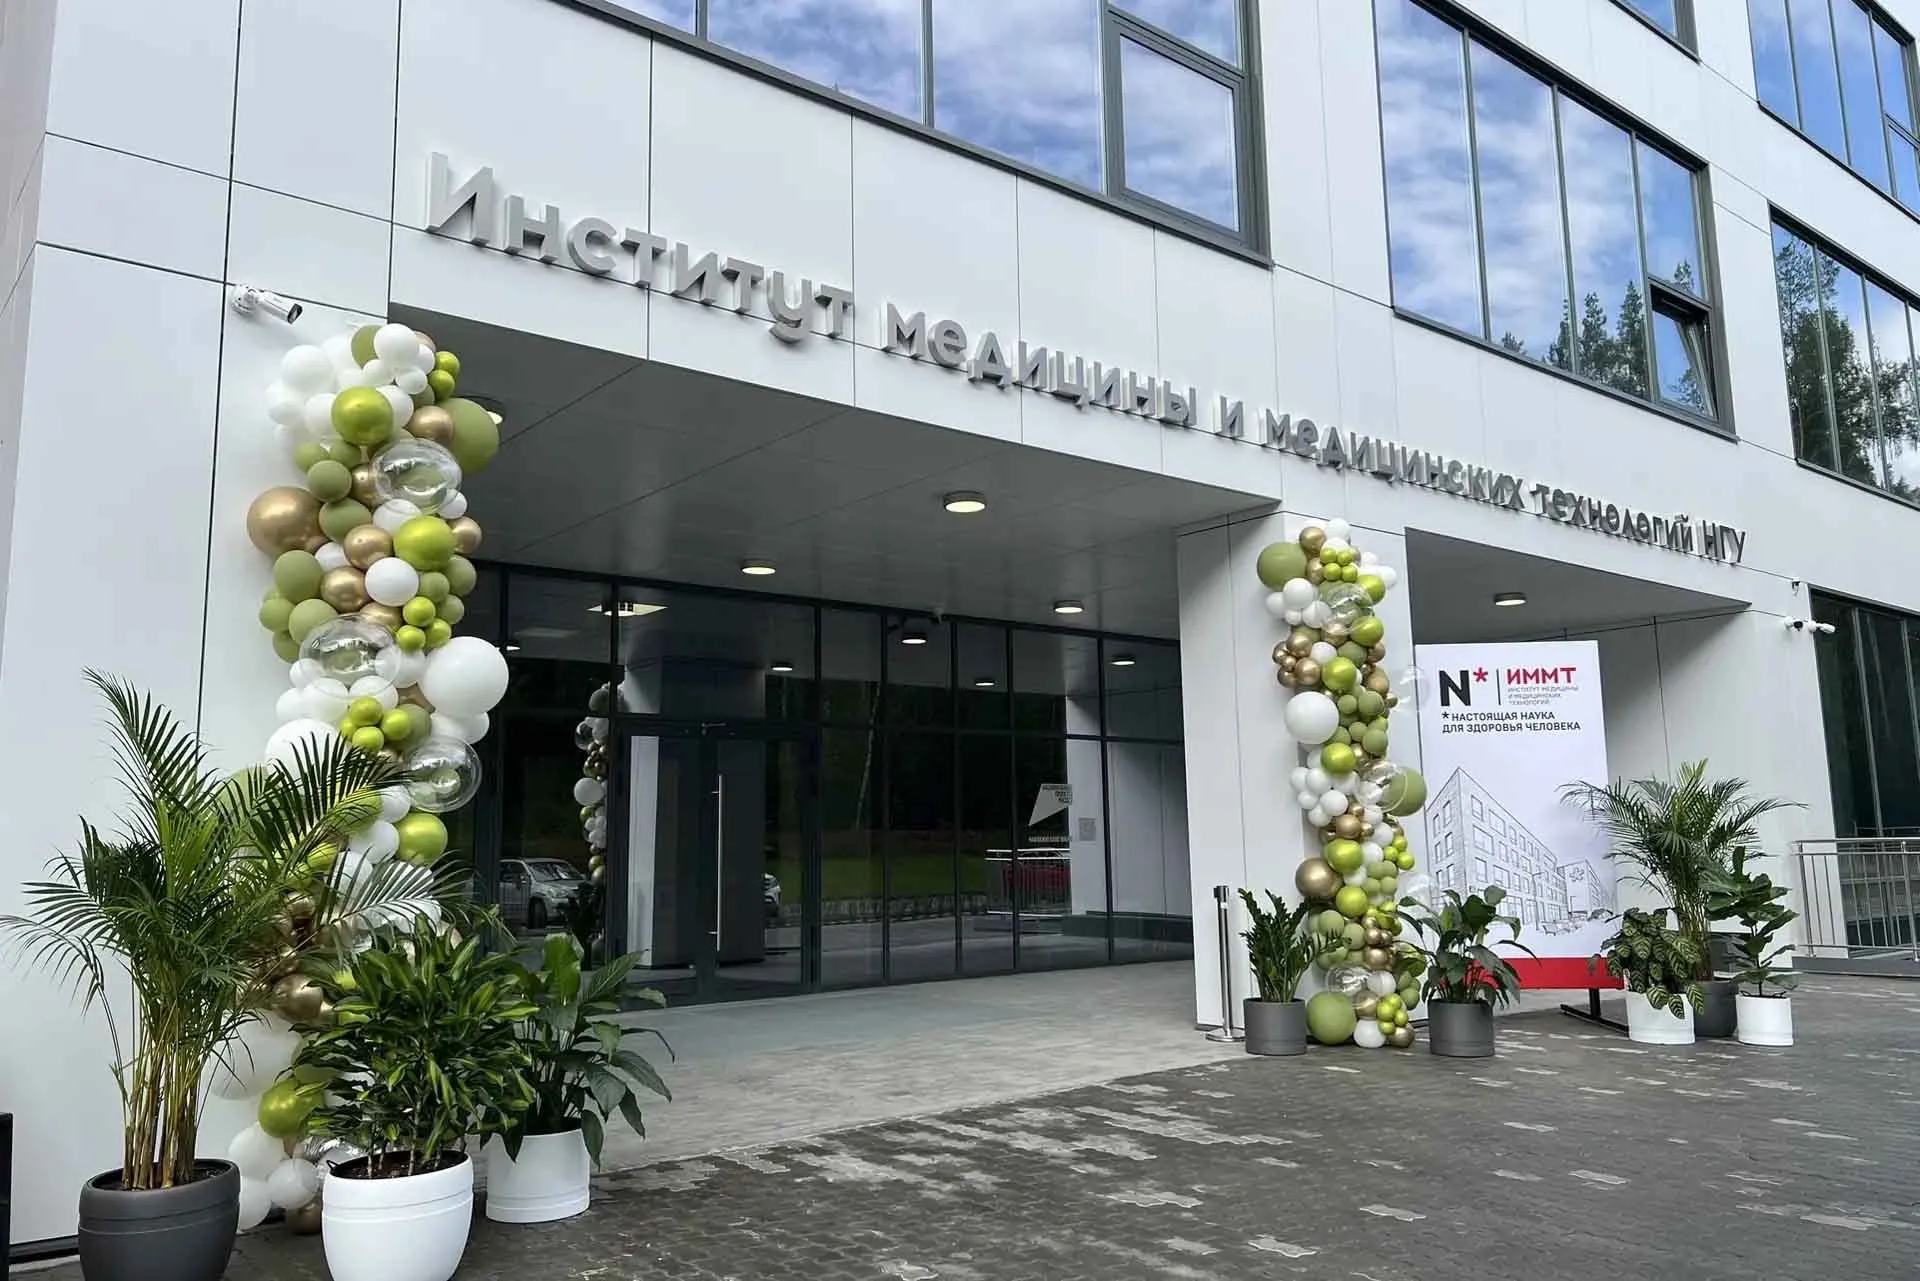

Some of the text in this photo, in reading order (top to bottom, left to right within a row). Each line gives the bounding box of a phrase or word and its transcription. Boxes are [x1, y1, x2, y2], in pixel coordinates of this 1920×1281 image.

[425, 152, 1746, 563] Институт медицины и медицинских технологий НГУ
[1507, 667, 1577, 685] ИММТ
[1520, 711, 1556, 720] НАУКА
[1442, 721, 1581, 734] ДЛЯ ЗДОРОВЬЯ ЧЕЛОВЕКА
